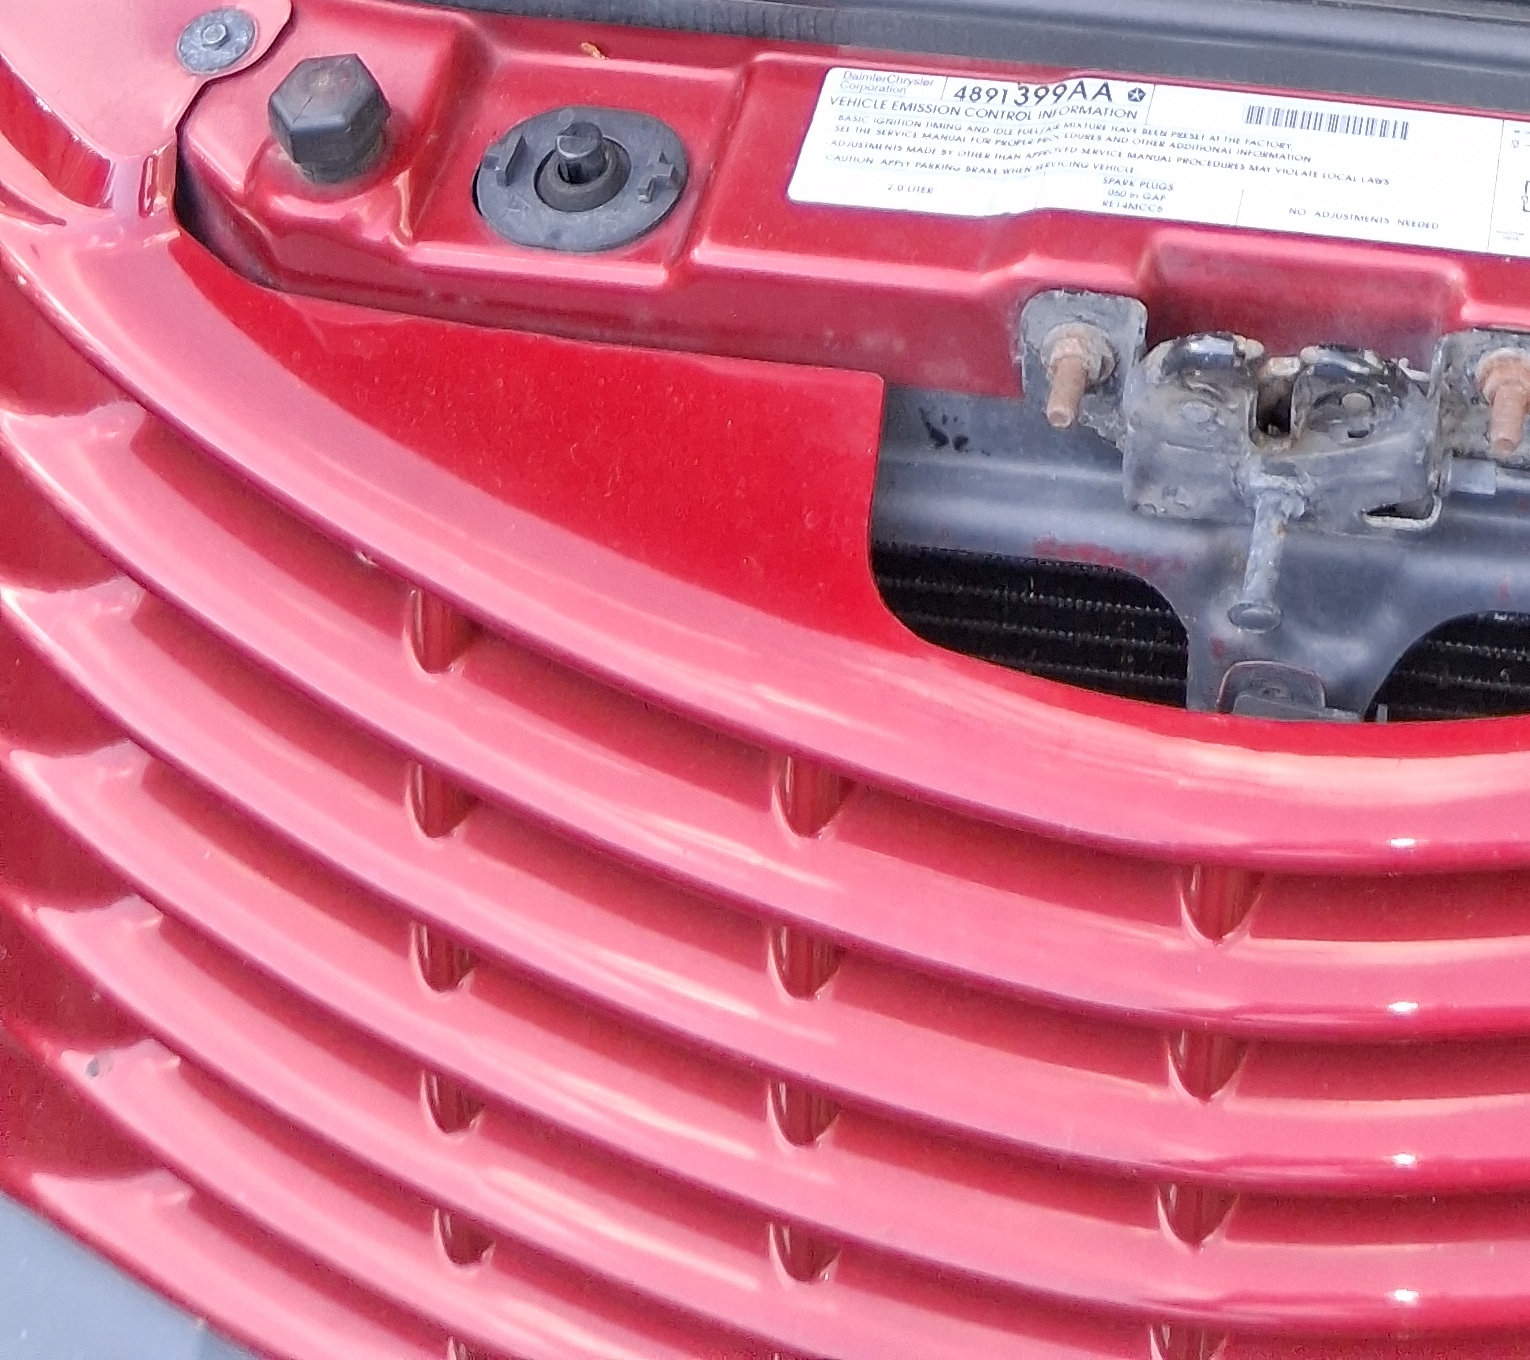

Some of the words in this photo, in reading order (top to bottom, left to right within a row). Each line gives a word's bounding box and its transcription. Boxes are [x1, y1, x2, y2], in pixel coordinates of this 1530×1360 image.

[843, 70, 934, 88] DaimlerChrysler
[840, 80, 907, 95] Corporation
[952, 79, 1113, 107] 4891399AA
[829, 95, 887, 111] VEHICLE
[892, 101, 961, 117] EMISSION
[964, 106, 1032, 122] CONTROL
[1038, 105, 1138, 120] INFORMATION
[966, 125, 989, 134] AND
[1105, 135, 1129, 144] AND
[1289, 207, 1307, 216] NO
